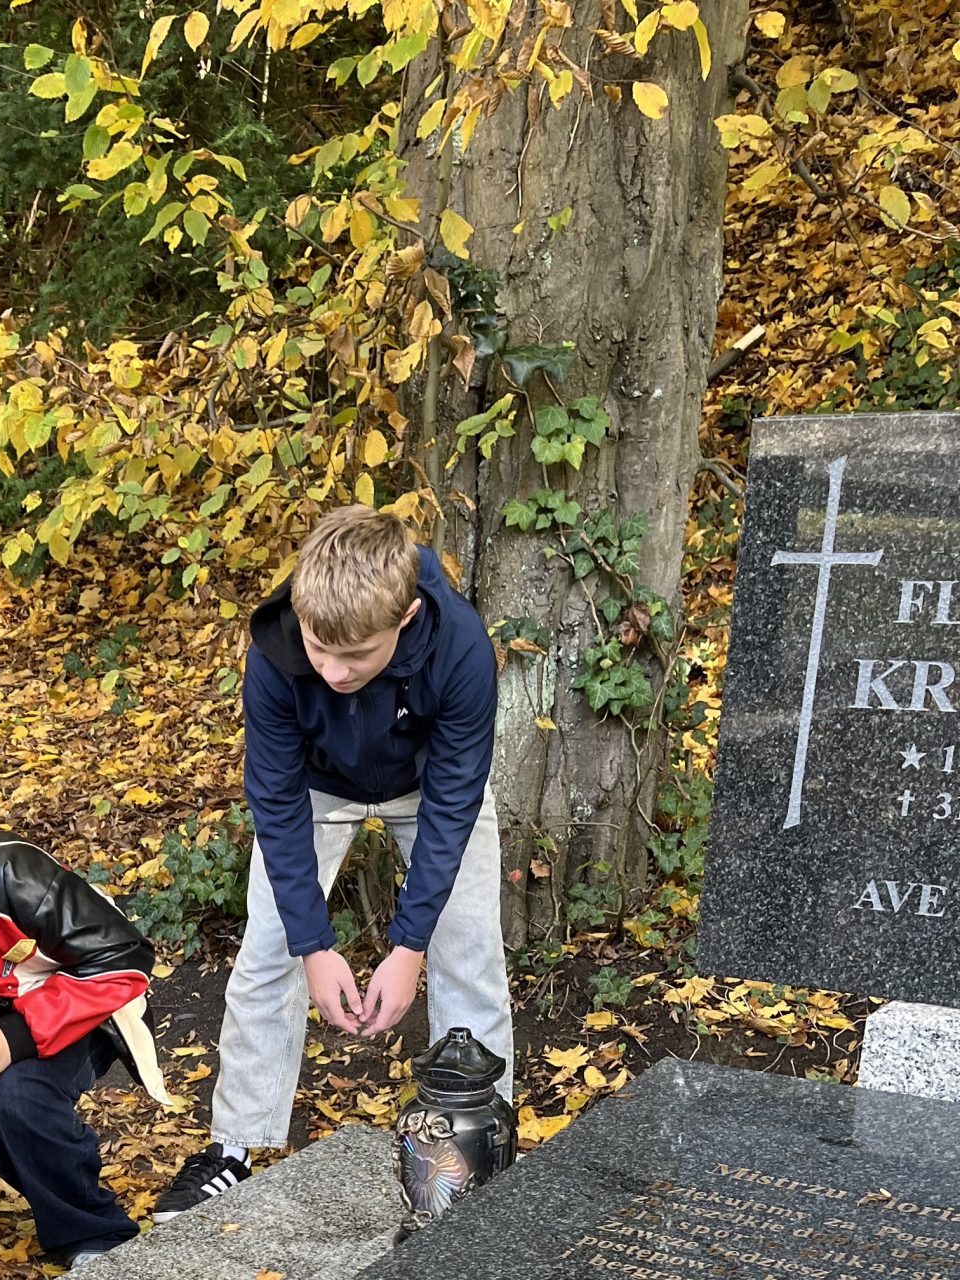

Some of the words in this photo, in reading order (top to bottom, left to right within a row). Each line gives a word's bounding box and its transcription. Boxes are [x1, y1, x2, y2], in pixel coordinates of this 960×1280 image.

[932, 791, 960, 820] 3
[853, 879, 948, 917] AVE
[706, 1163, 848, 1200] Mistrzu
[596, 1219, 700, 1250] Zawsze
[823, 1217, 856, 1231] za
